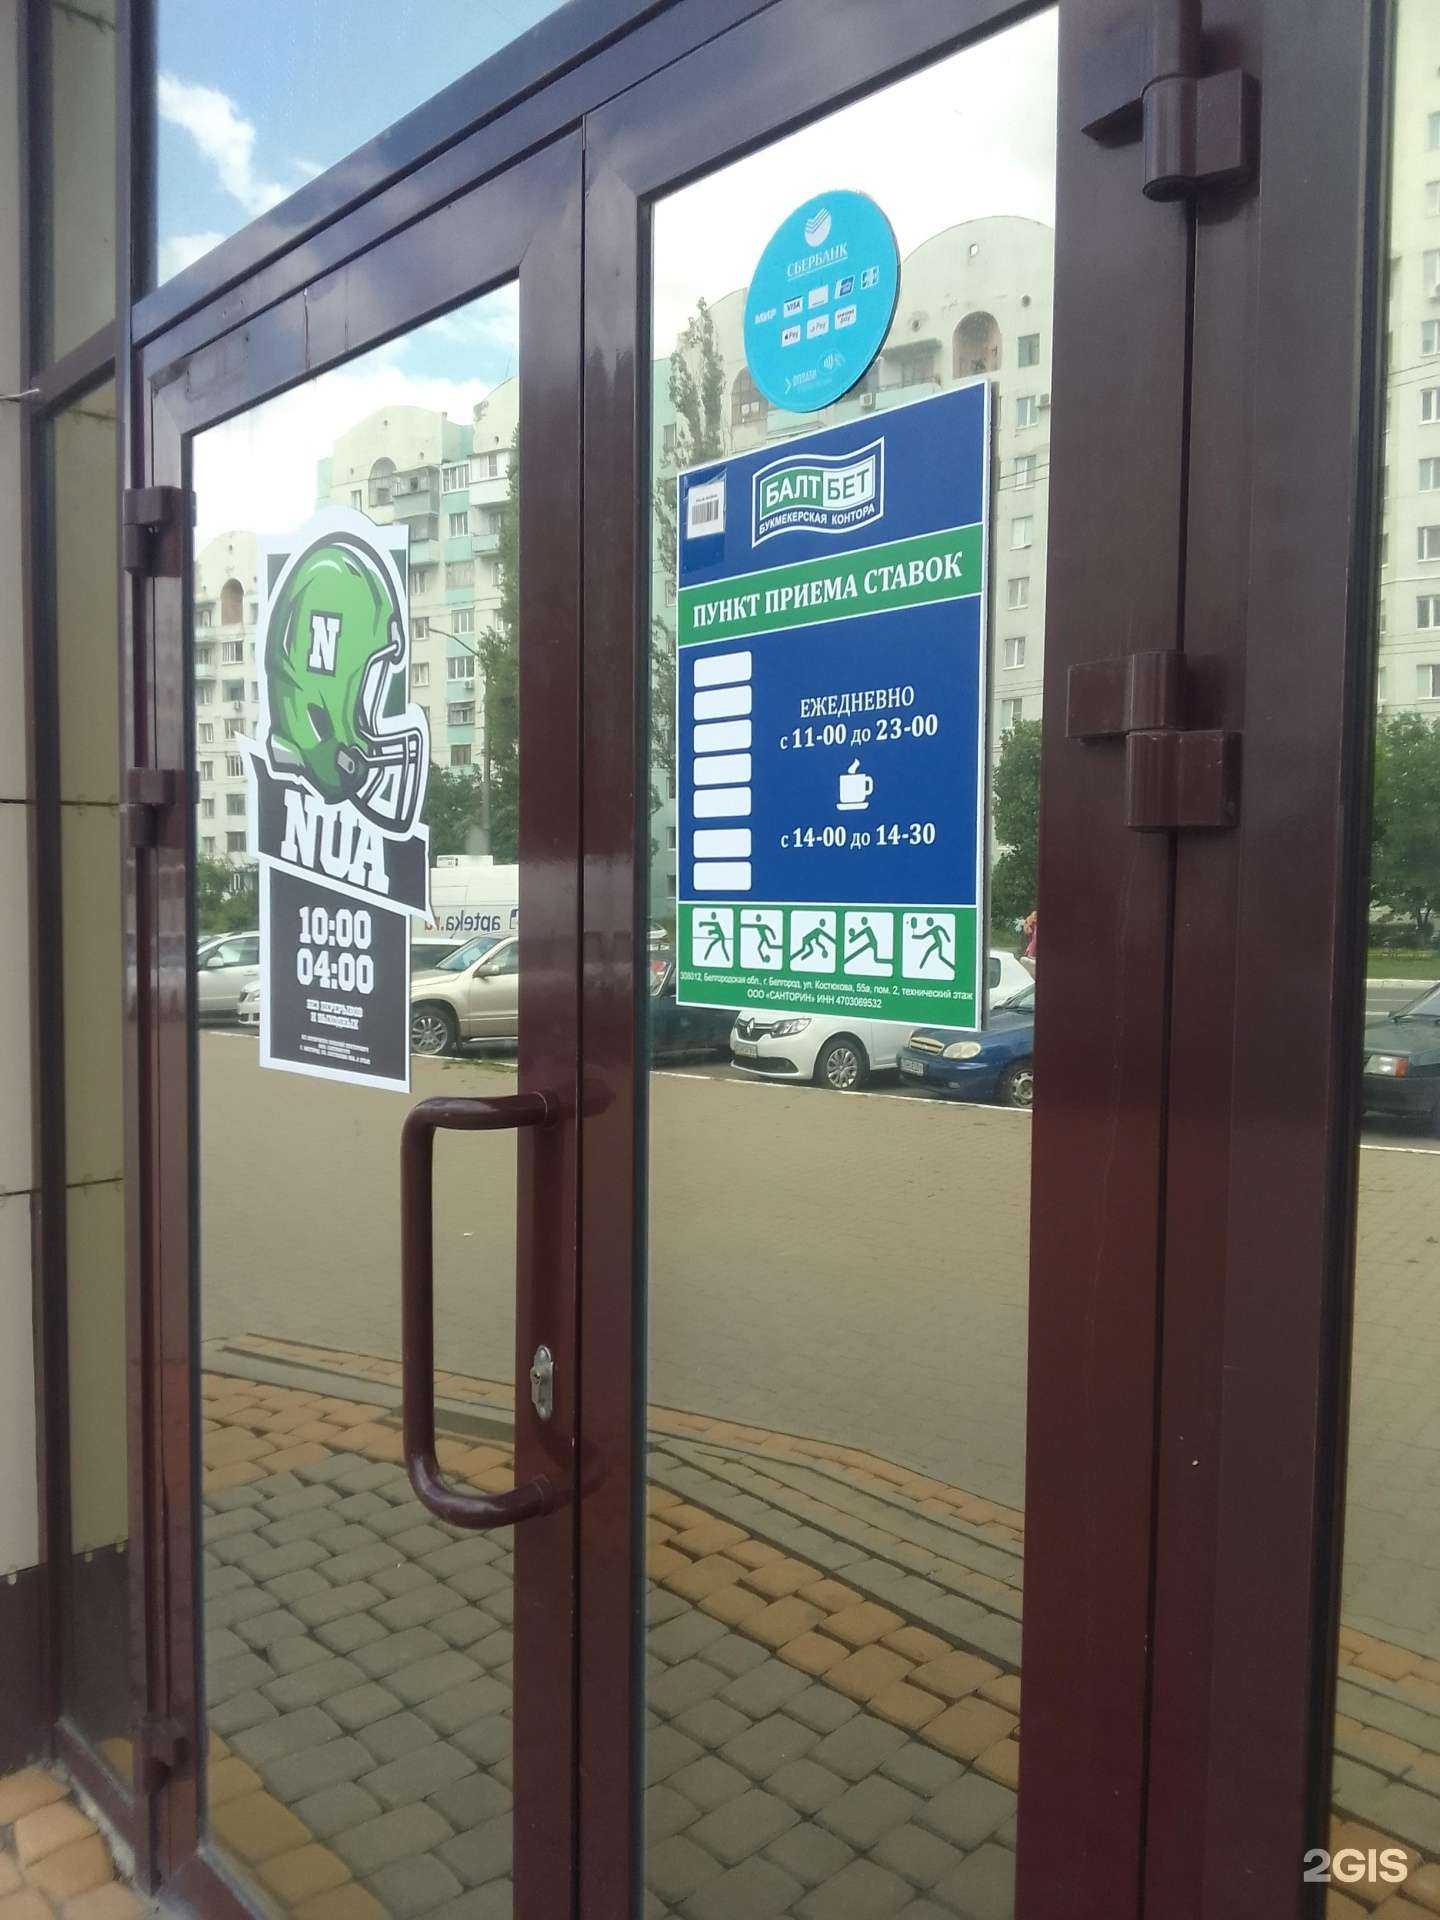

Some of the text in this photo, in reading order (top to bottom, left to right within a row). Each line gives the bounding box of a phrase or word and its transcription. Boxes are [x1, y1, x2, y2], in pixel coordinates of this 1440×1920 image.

[787, 243, 848, 276] СБЕРБАНК
[759, 503, 875, 534] БУКМЕКЕРСКАЯ КОНТОРА
[693, 551, 963, 628] ПУНКТ ПРИЕМА СТАВОК
[308, 615, 341, 672] N
[800, 686, 915, 718] ЕЖЕДНЕВНО
[780, 714, 938, 749] с 11-00 до 23-00
[280, 788, 390, 894] NUA
[780, 822, 936, 849] с 14-00 до 14-30
[298, 906, 372, 950] 10:00
[296, 948, 374, 994] 04:00
[704, 973, 746, 985] Белгородская
[803, 980, 814, 989] ул.
[874, 986, 890, 995] пом.
[902, 987, 952, 999] технический
[952, 991, 973, 1000] этаж
[747, 989, 764, 999] ООО
[766, 990, 815, 1003] «САНТОРИН»
[816, 994, 836, 1005] ИНН
